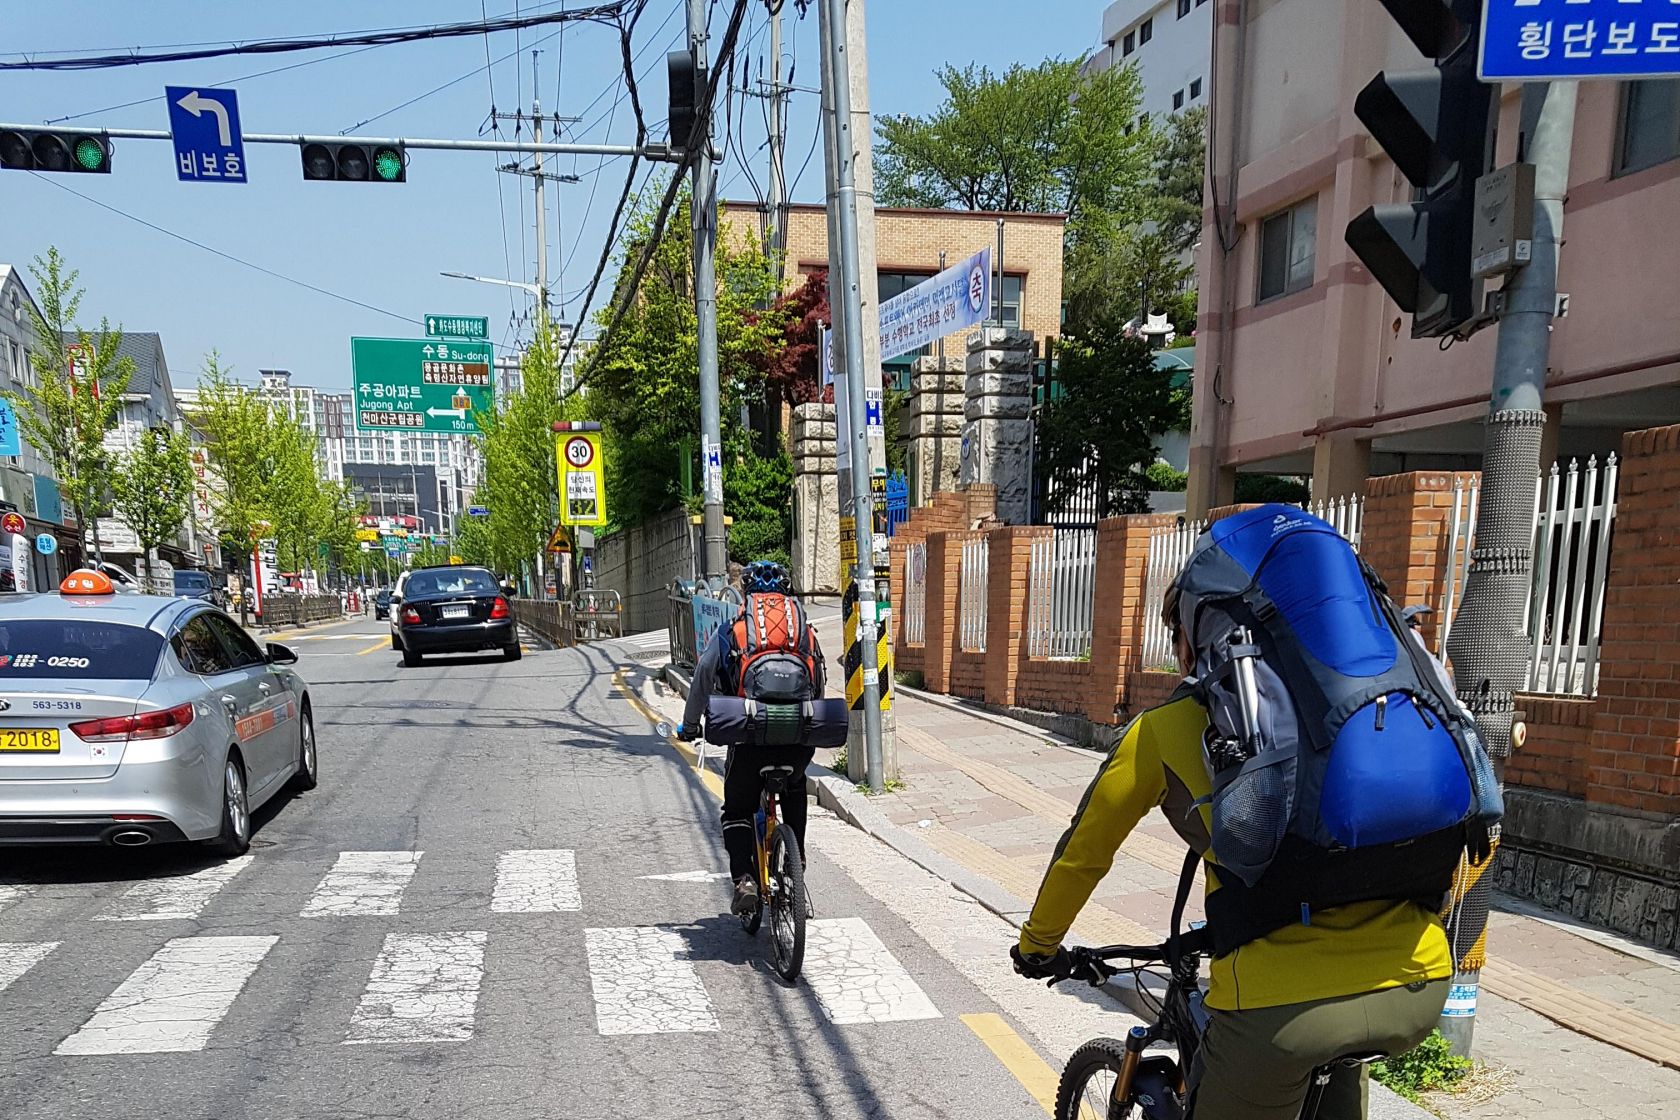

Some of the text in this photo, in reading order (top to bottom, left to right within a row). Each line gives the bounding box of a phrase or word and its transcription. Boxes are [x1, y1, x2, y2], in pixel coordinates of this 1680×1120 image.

[1517, 19, 1680, 60] 횡단보도
[179, 149, 243, 178] 비보호
[971, 272, 983, 303] 축
[917, 309, 941, 334] 전국최초
[943, 301, 956, 323] 선정
[422, 344, 489, 362] 수동 Su-dong
[359, 383, 422, 399] 주공아파트
[360, 400, 413, 411] Jugong Apt
[362, 411, 423, 426] 천마산군립공원
[571, 445, 588, 458] 30
[33, 701, 82, 710] 563-5318
